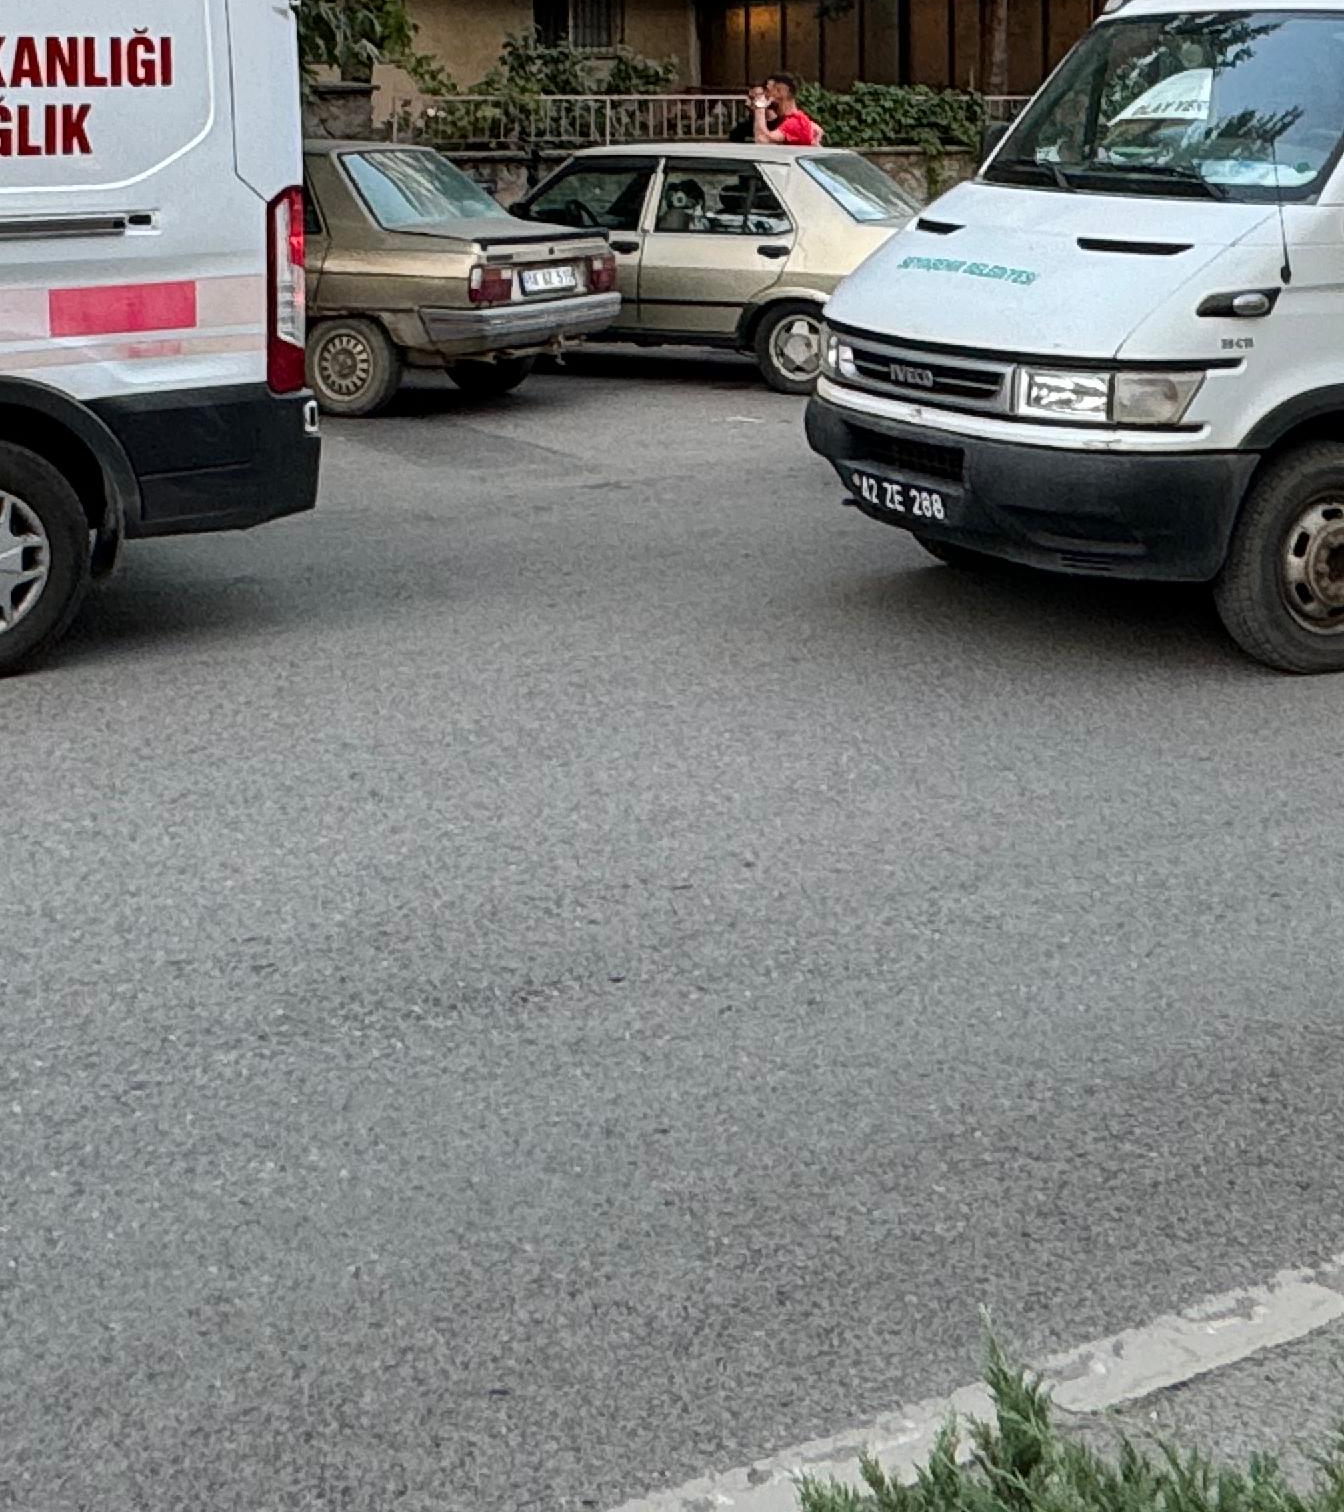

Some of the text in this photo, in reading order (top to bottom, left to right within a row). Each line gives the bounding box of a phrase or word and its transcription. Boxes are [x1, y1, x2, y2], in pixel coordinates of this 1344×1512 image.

[889, 362, 935, 388] IVECO
[861, 474, 880, 504] 42
[881, 481, 906, 513] ZE
